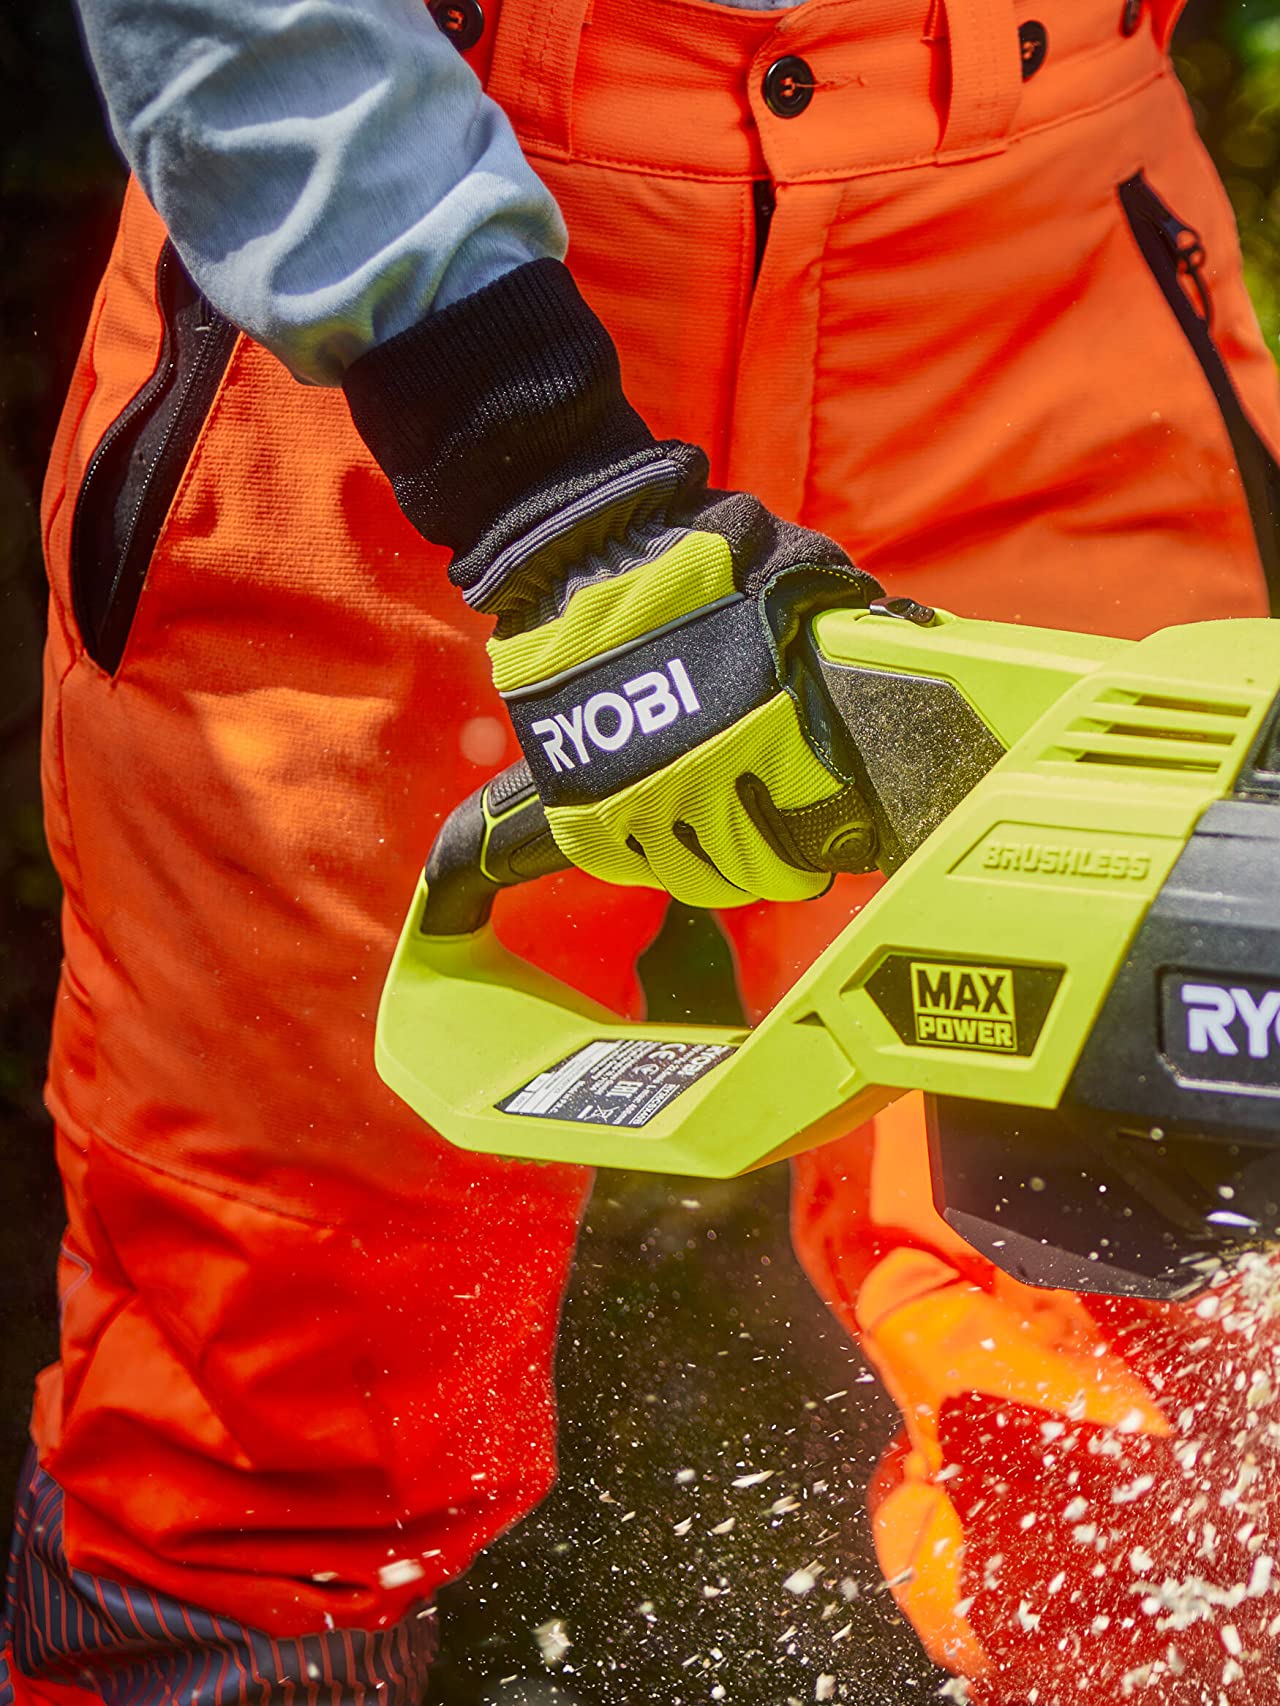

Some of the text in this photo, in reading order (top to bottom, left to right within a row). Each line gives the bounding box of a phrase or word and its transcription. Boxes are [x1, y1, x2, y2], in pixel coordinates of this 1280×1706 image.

[531, 658, 700, 773] RYOBI
[983, 845, 1152, 881] BRUSHLESS
[916, 969, 1006, 1016] MAX
[918, 1015, 1014, 1047] POWER
